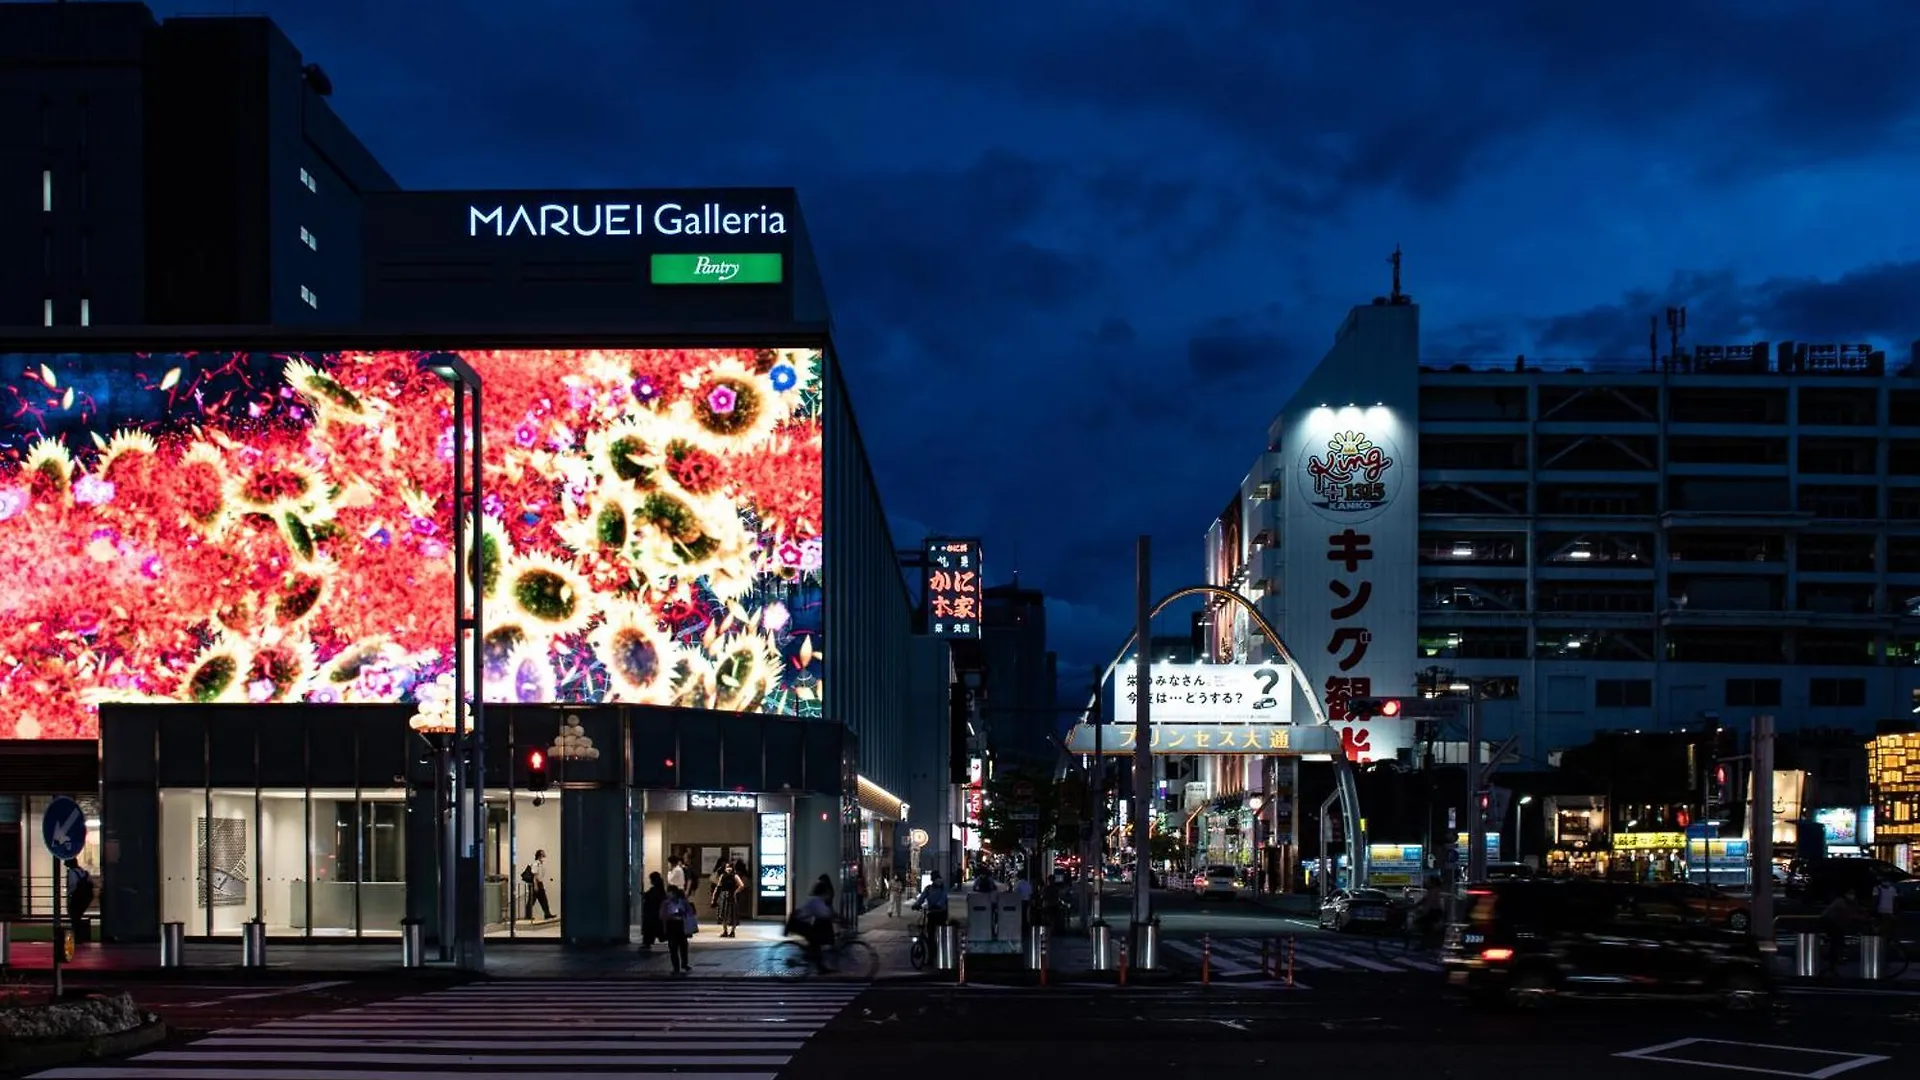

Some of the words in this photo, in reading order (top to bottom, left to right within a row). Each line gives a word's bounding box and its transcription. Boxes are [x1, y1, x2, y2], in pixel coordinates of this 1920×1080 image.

[470, 204, 643, 236] MARUEI
[653, 203, 787, 235] Galleria
[694, 256, 739, 281] Pantry
[1307, 446, 1393, 494] King
[929, 570, 975, 592] かに
